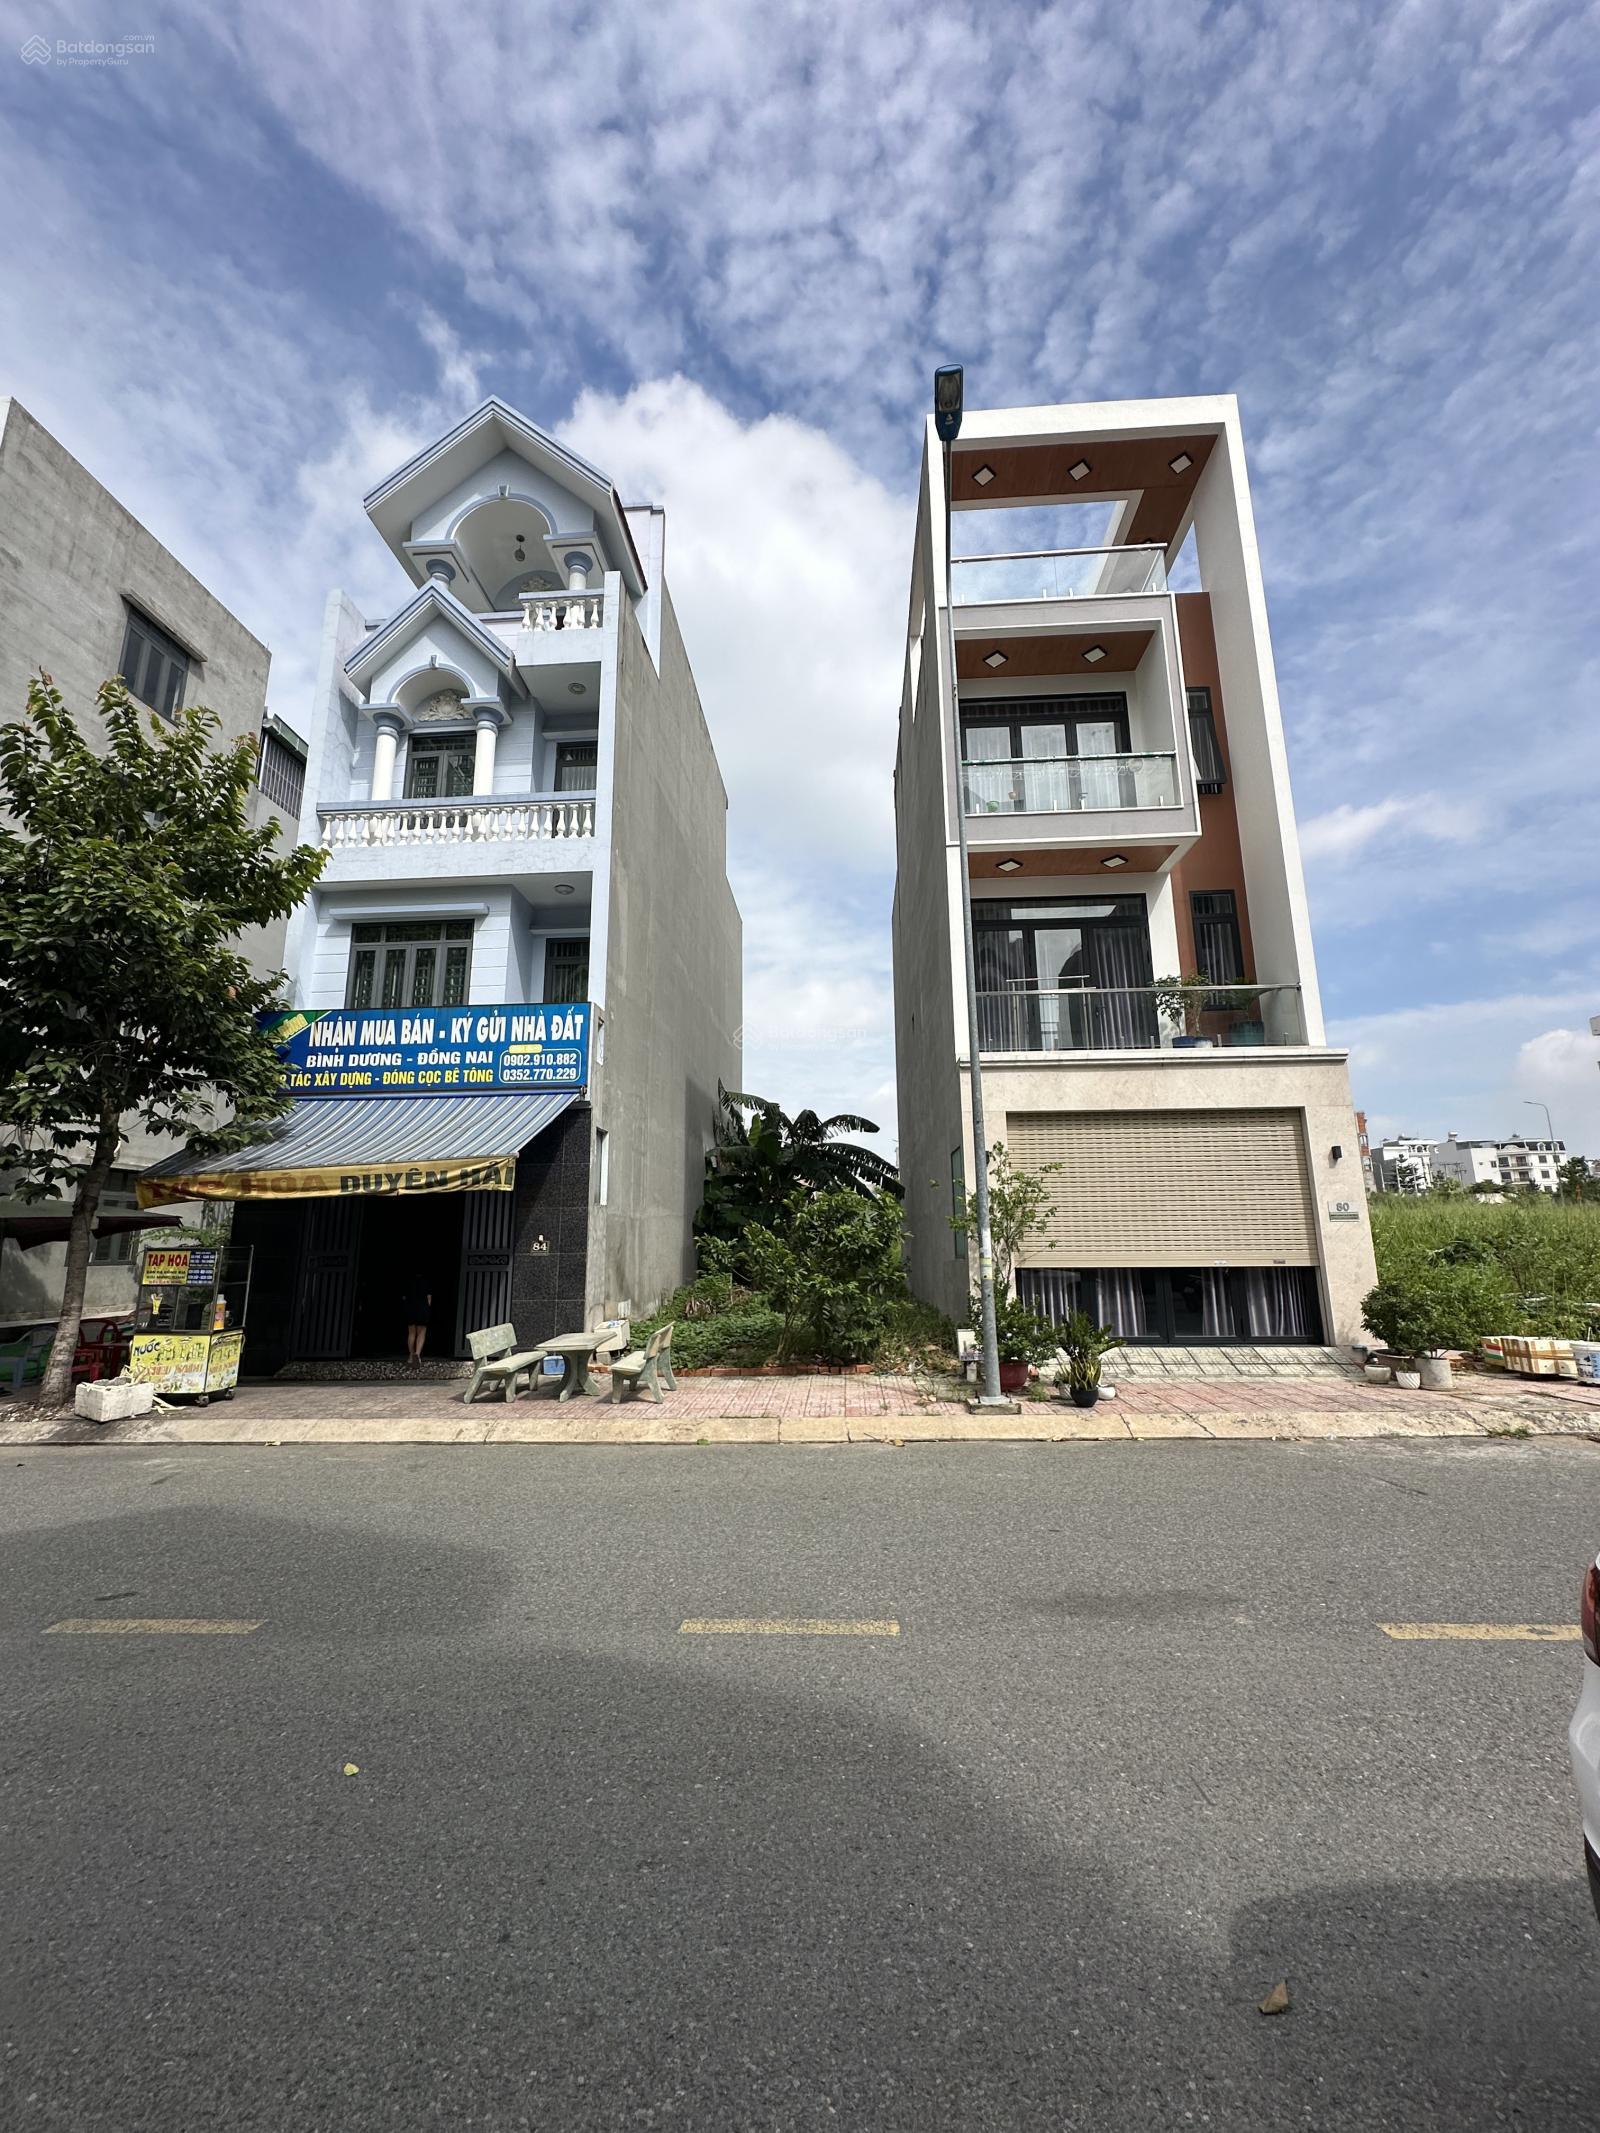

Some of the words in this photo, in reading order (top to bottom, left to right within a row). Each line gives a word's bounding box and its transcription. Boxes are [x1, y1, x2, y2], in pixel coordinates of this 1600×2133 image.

[359, 1019, 397, 1046] MUA
[400, 1013, 435, 1045] BÁN
[450, 1012, 474, 1044] KÝ
[476, 1009, 507, 1044] GỬI
[510, 1010, 547, 1042] NHÀ
[551, 1006, 584, 1041] ĐẤT
[305, 1053, 345, 1068] BÌNH
[348, 1052, 402, 1067] DƯƠNG
[417, 1048, 461, 1065] ĐỒNG
[465, 1050, 493, 1064] NAI
[503, 1053, 577, 1066] 0902.910.882
[290, 1071, 312, 1087] TÁC
[314, 1071, 338, 1087] XÂY
[340, 1071, 372, 1088] DỰNG
[382, 1069, 415, 1085] ĐÓNG
[418, 1071, 441, 1086] CỌC
[444, 1068, 459, 1083] BÊ
[463, 1067, 493, 1083] TÔNG
[503, 1068, 577, 1081] 0352.770.229
[340, 1168, 448, 1193] DUYÊN
[532, 1242, 547, 1251] 84
